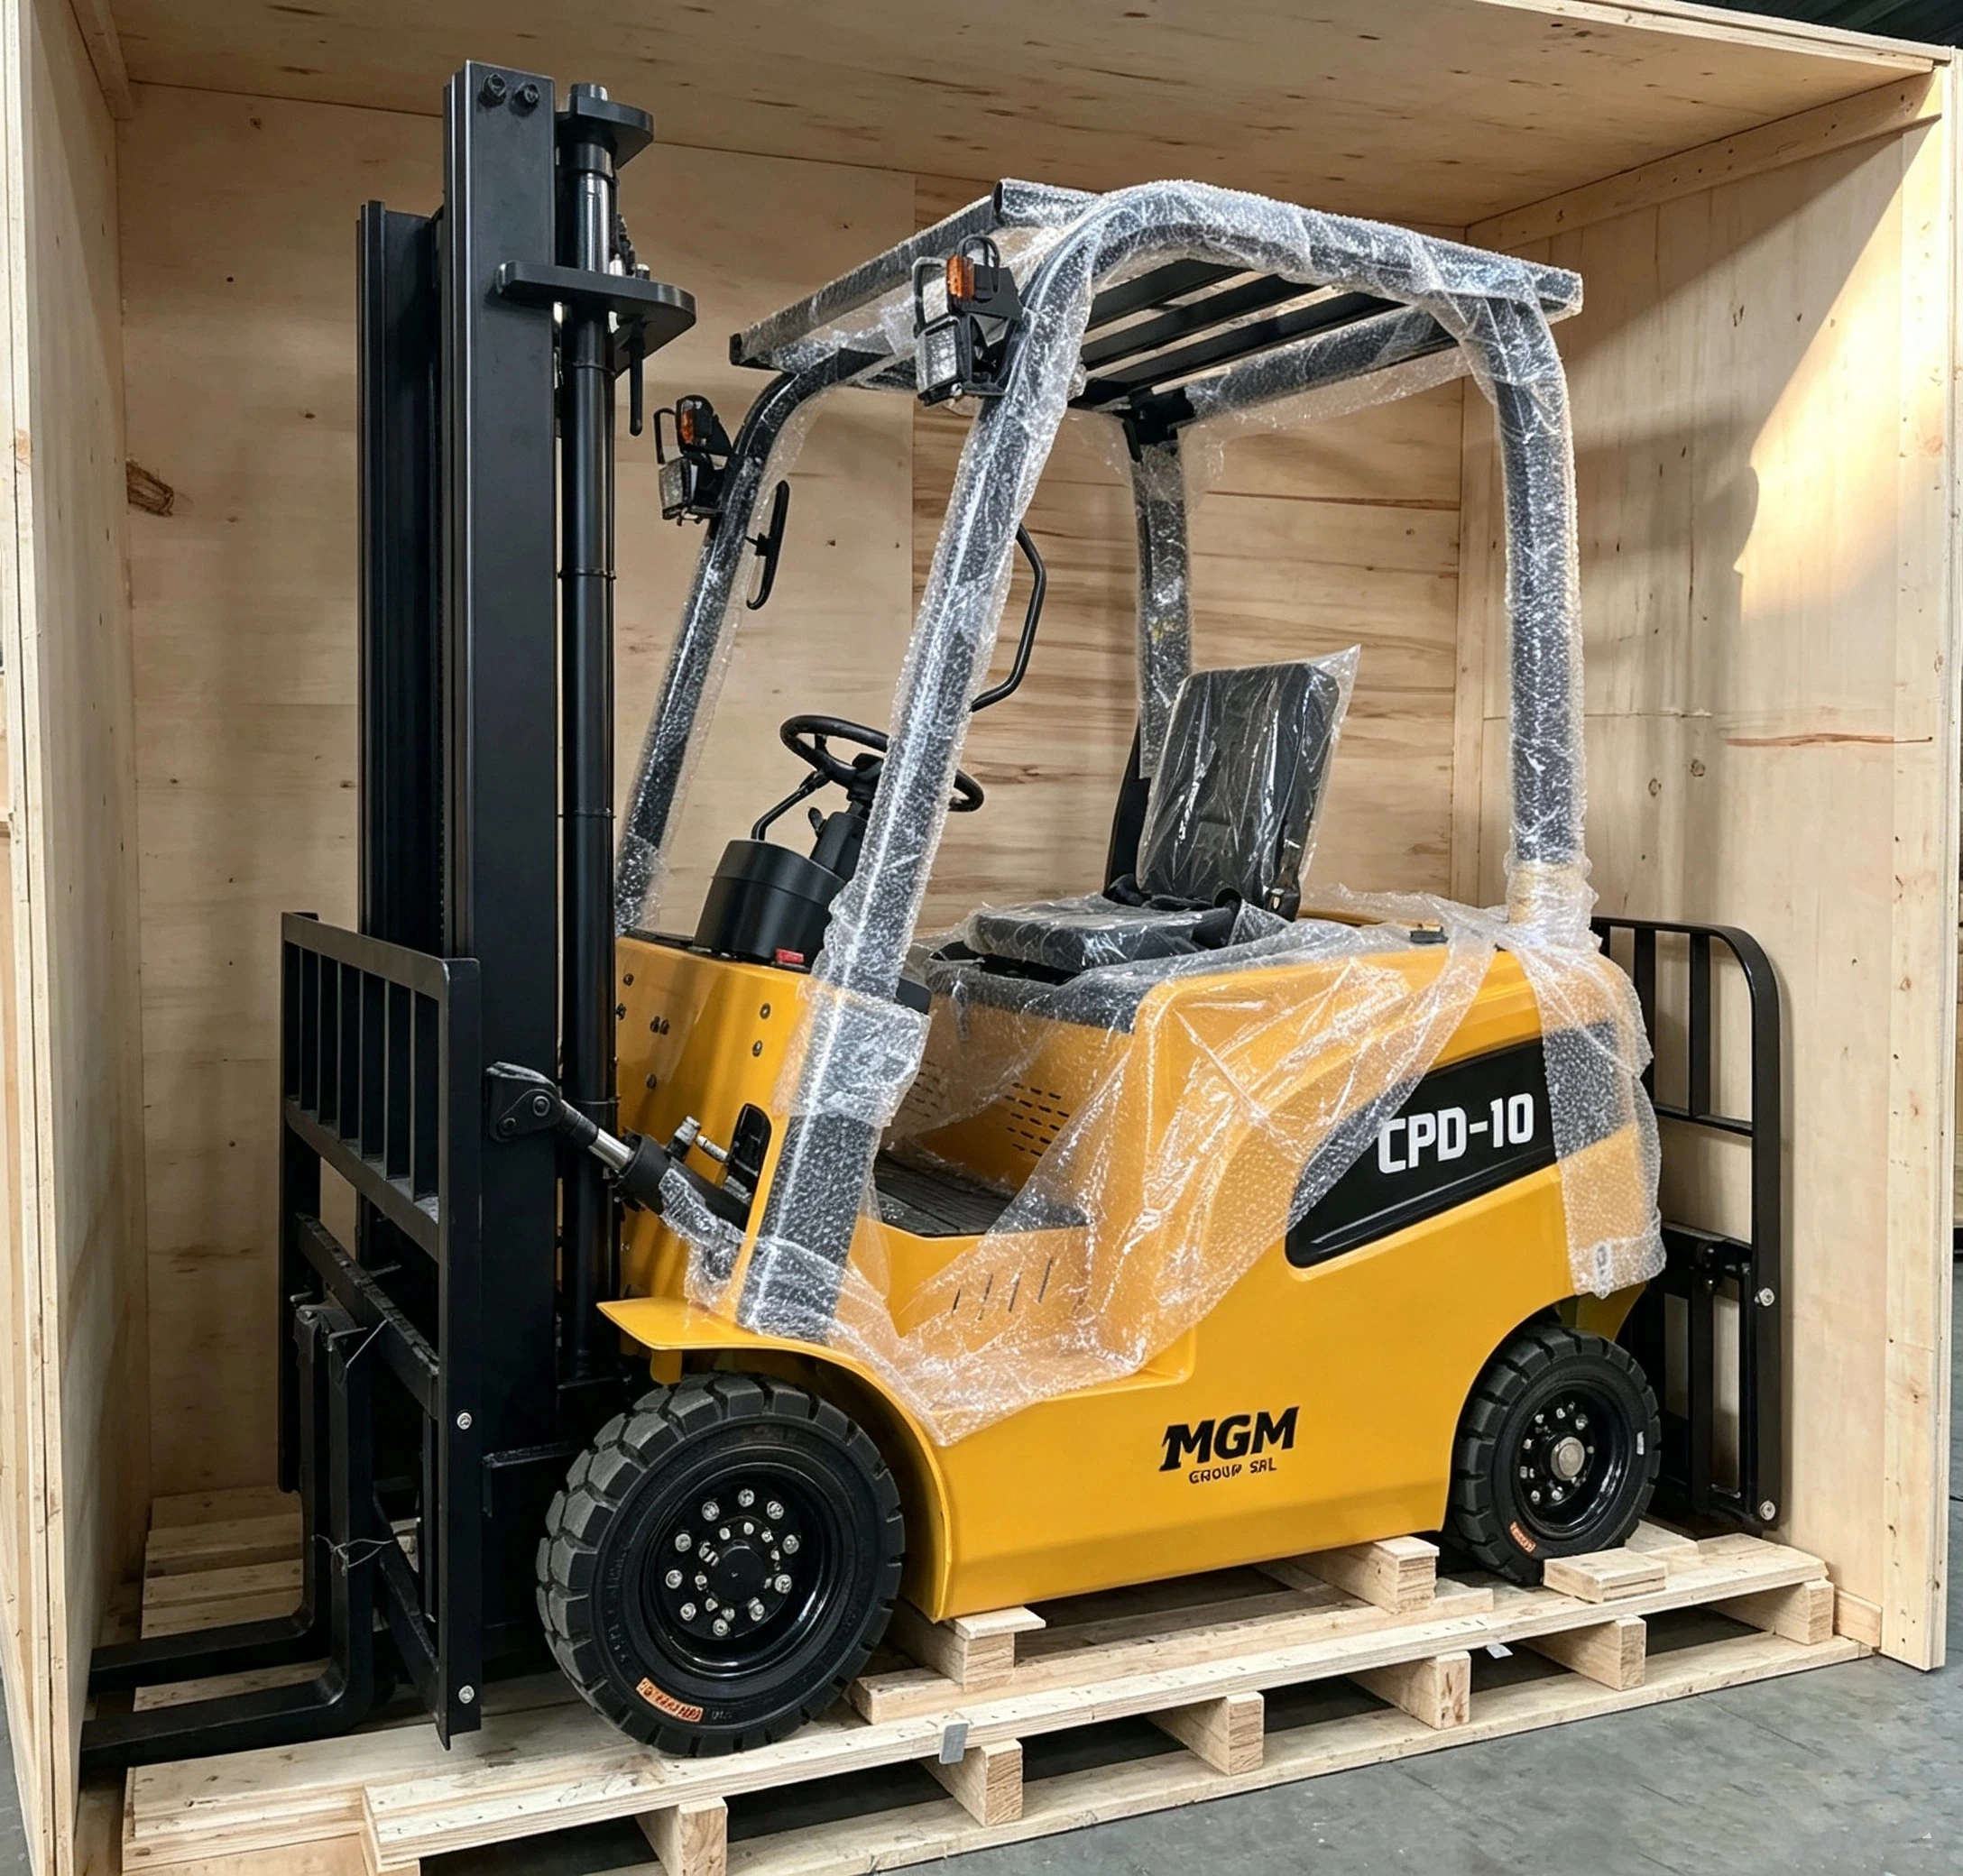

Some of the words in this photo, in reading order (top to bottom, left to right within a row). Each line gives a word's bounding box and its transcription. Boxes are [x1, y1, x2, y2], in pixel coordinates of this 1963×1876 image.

[1378, 1092, 1534, 1173] CPD-10
[1159, 1405, 1300, 1472] MGM
[1189, 1464, 1242, 1484] GROUP
[1249, 1457, 1277, 1474] SRL
